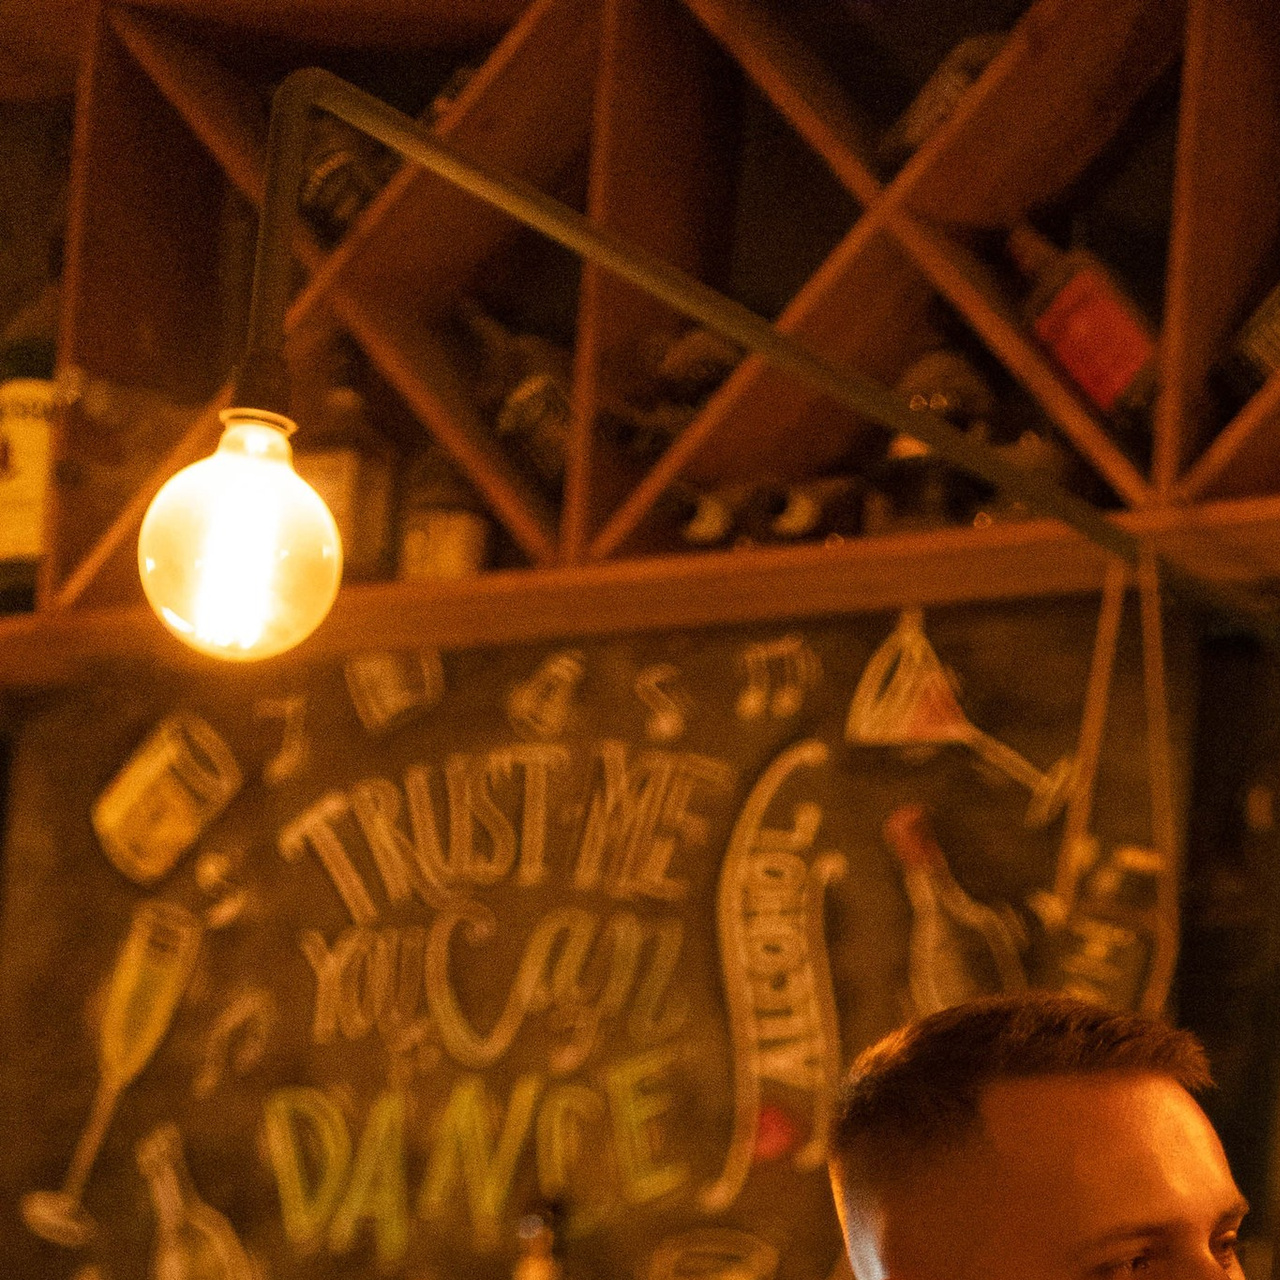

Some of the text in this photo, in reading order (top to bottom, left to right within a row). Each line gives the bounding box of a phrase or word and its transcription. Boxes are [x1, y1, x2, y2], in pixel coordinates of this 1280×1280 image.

[277, 736, 738, 926] TRUST ME
[742, 800, 824, 1092] ALCOHOL
[264, 1040, 694, 1266] DANCE
